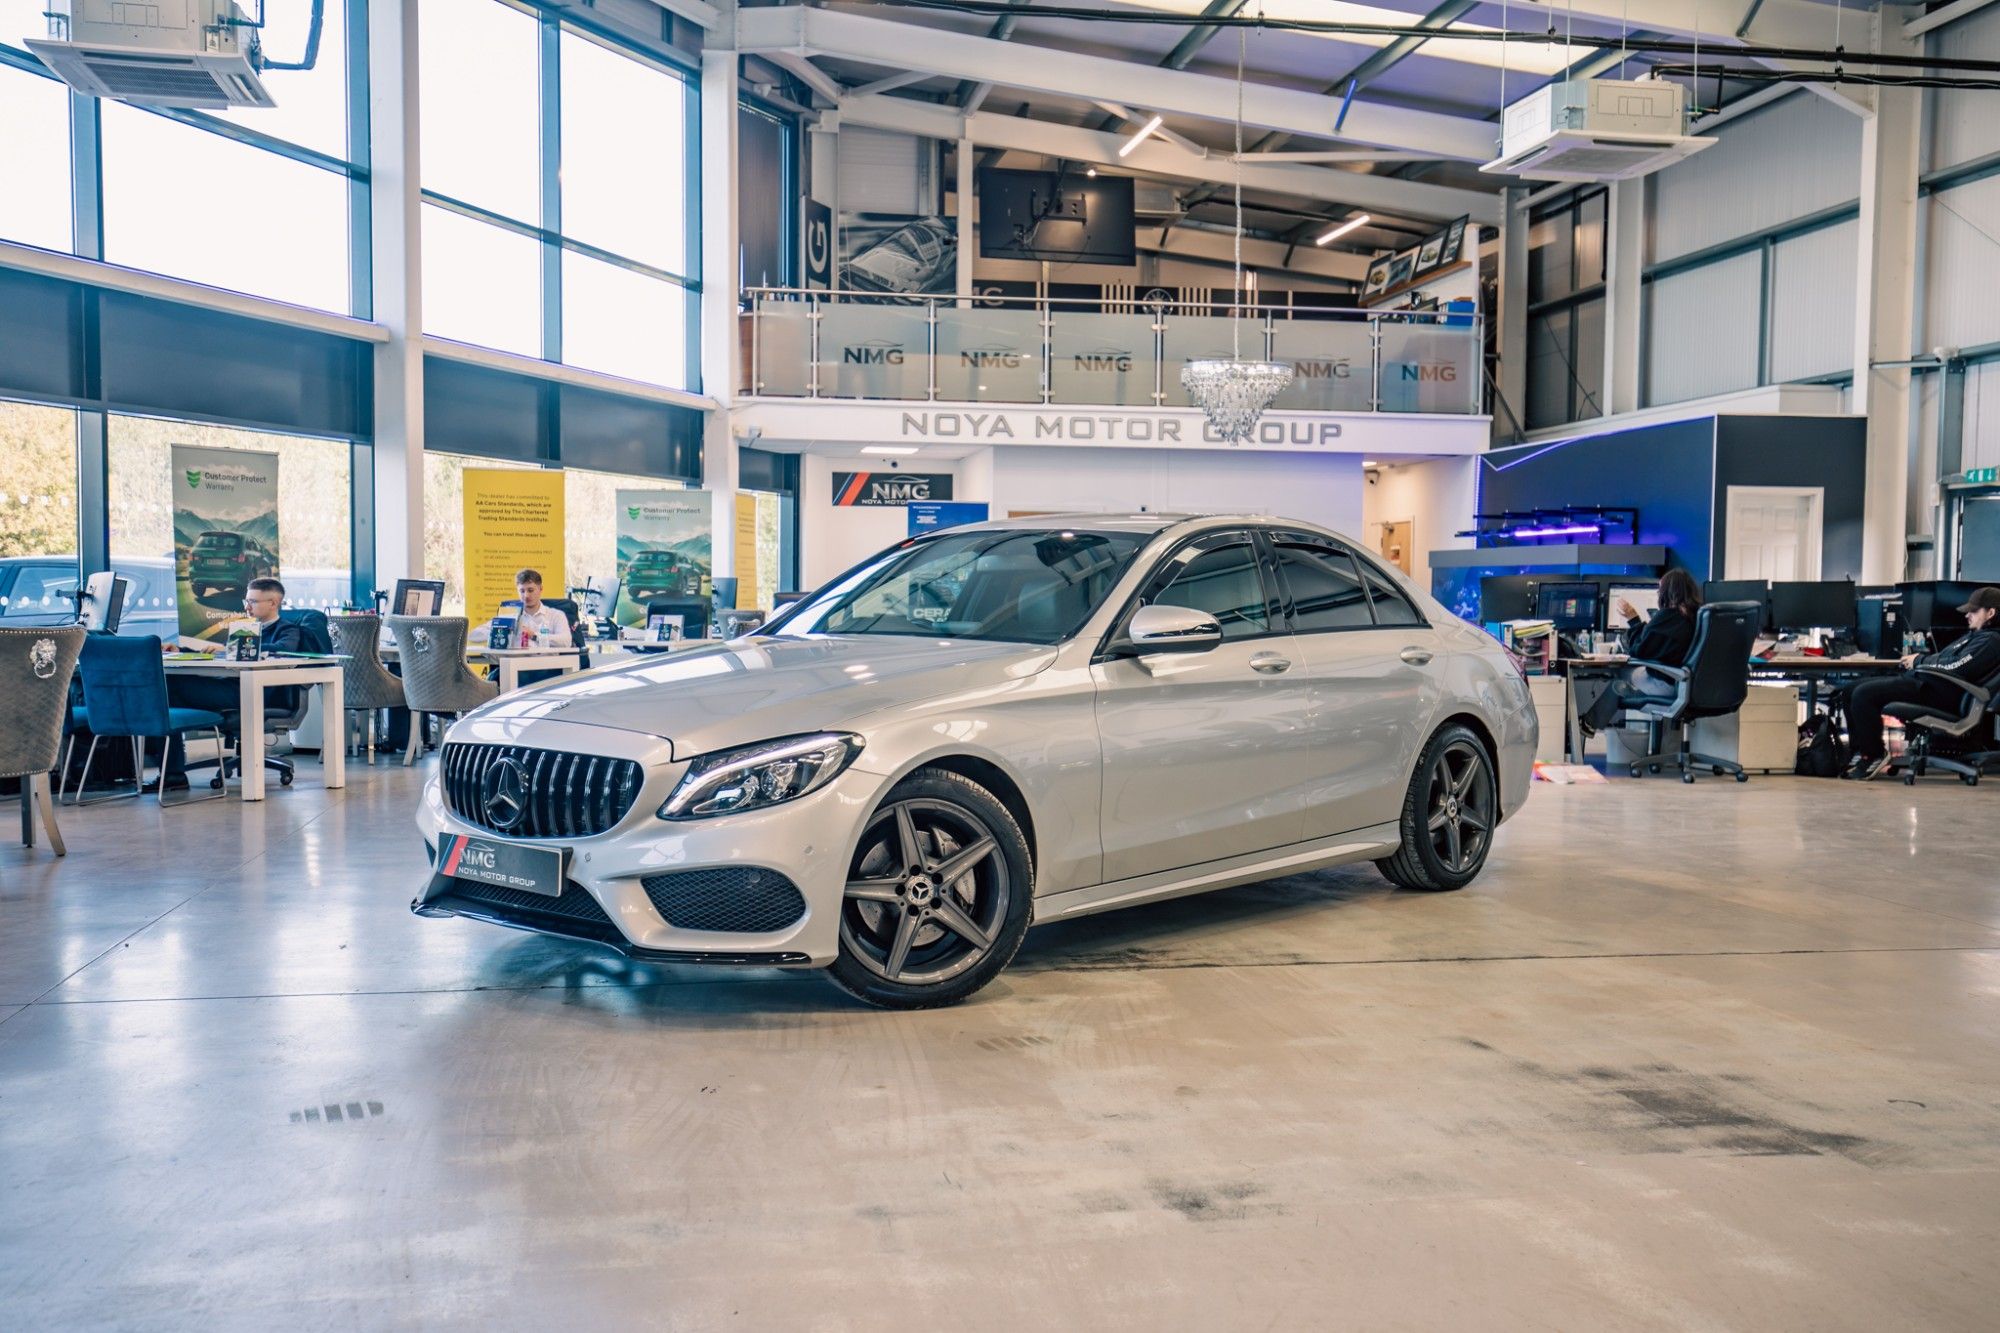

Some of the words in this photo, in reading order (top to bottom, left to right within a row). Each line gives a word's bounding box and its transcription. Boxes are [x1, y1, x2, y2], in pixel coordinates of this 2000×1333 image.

[844, 347, 904, 365] NMG
[960, 351, 1021, 369] NMG
[1074, 355, 1132, 372] NMG
[1295, 362, 1350, 378] NMG
[1402, 365, 1457, 382] NMG
[902, 412, 1014, 437] NOYA
[1035, 416, 1181, 441] MOTOR
[204, 472, 239, 481] Customer
[240, 474, 267, 484] Protect
[205, 483, 235, 492] Warranty
[871, 483, 930, 500] NMG
[459, 848, 496, 869] NMG
[458, 866, 478, 876] NOYA
[480, 871, 507, 882] MOTOR
[508, 876, 536, 888] GROUP
